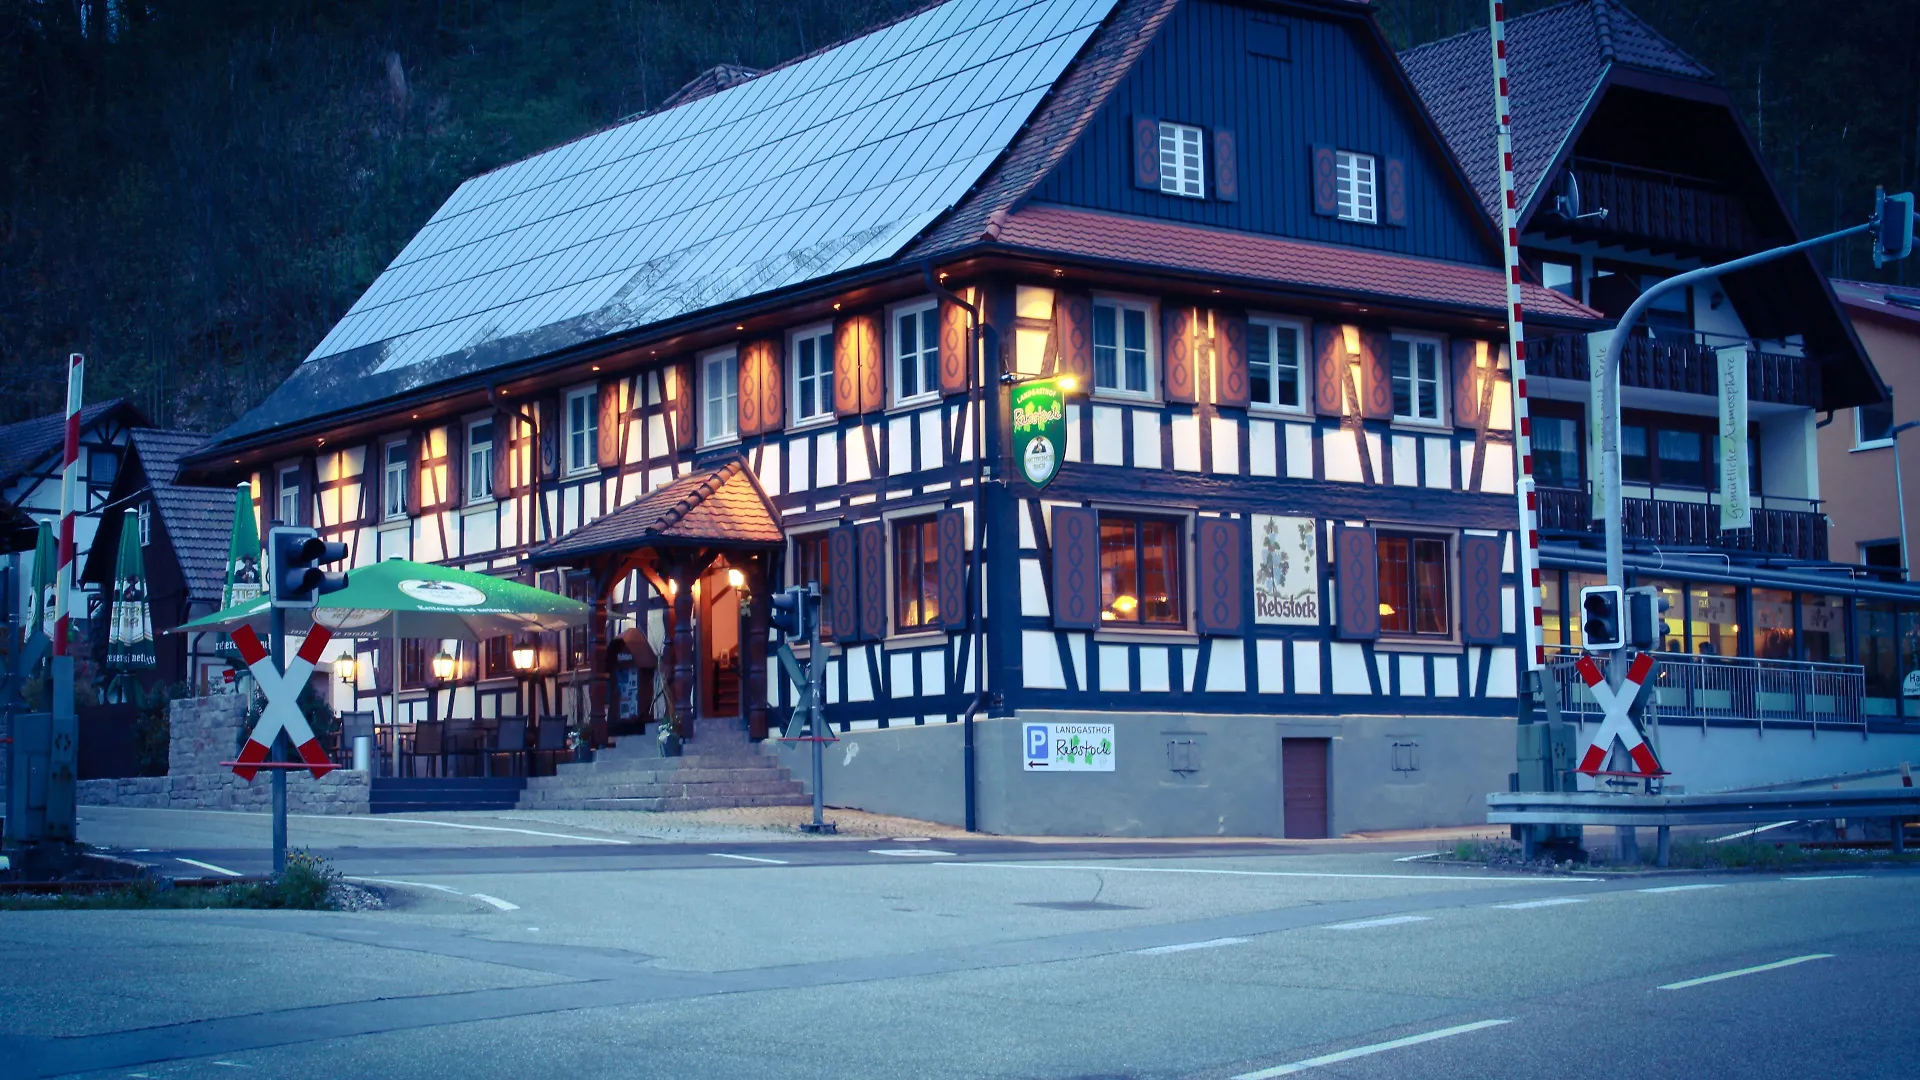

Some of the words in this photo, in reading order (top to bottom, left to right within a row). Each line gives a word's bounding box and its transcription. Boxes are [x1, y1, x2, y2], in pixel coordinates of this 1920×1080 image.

[1016, 388, 1057, 404] LANDGASTHOF
[1256, 591, 1317, 619] Rebstock
[1055, 726, 1111, 734] LANDGASTHOF
[1030, 729, 1047, 755] P
[1056, 738, 1111, 757] Rebstock
